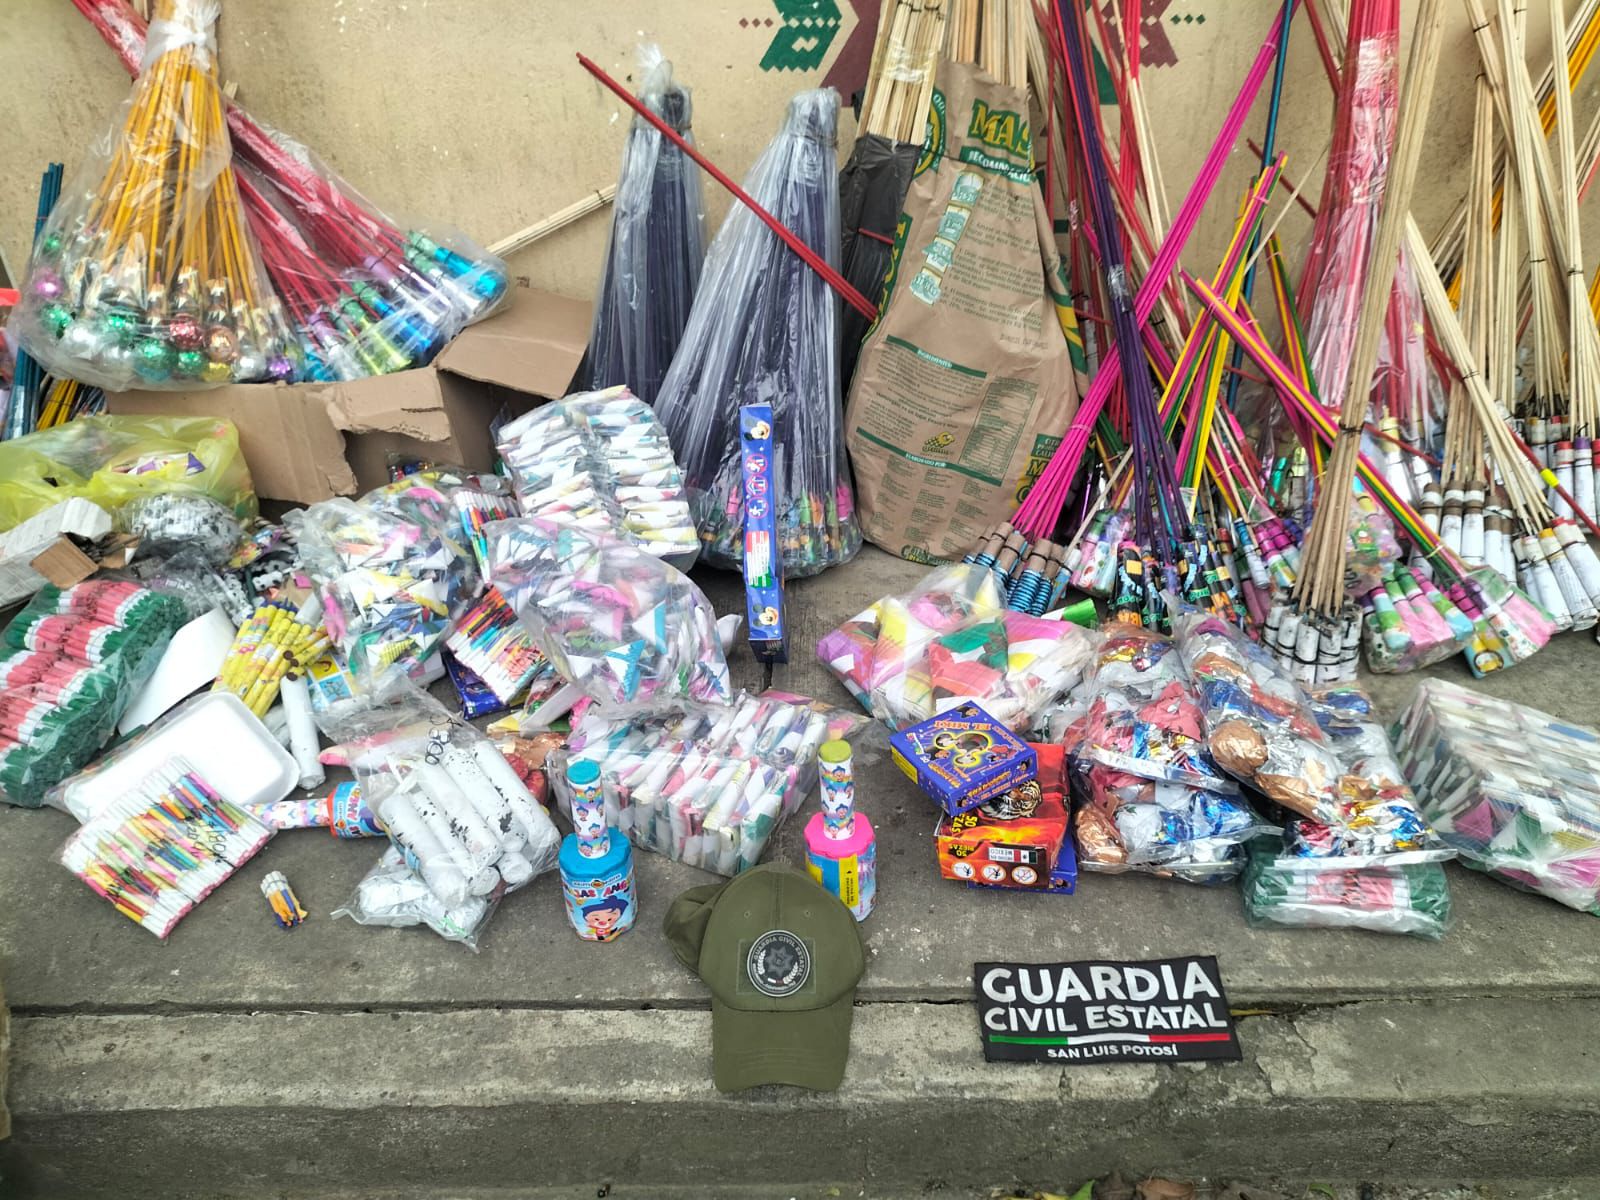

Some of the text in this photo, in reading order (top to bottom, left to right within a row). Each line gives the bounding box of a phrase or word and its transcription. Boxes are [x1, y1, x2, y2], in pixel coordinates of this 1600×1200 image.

[753, 936, 777, 960] GUARDIA
[982, 961, 1221, 1004] GUARDIA
[984, 1002, 1228, 1032] CIVIL ESTATAL
[1047, 1044, 1179, 1058] SAN LUIS POTOSÍ
